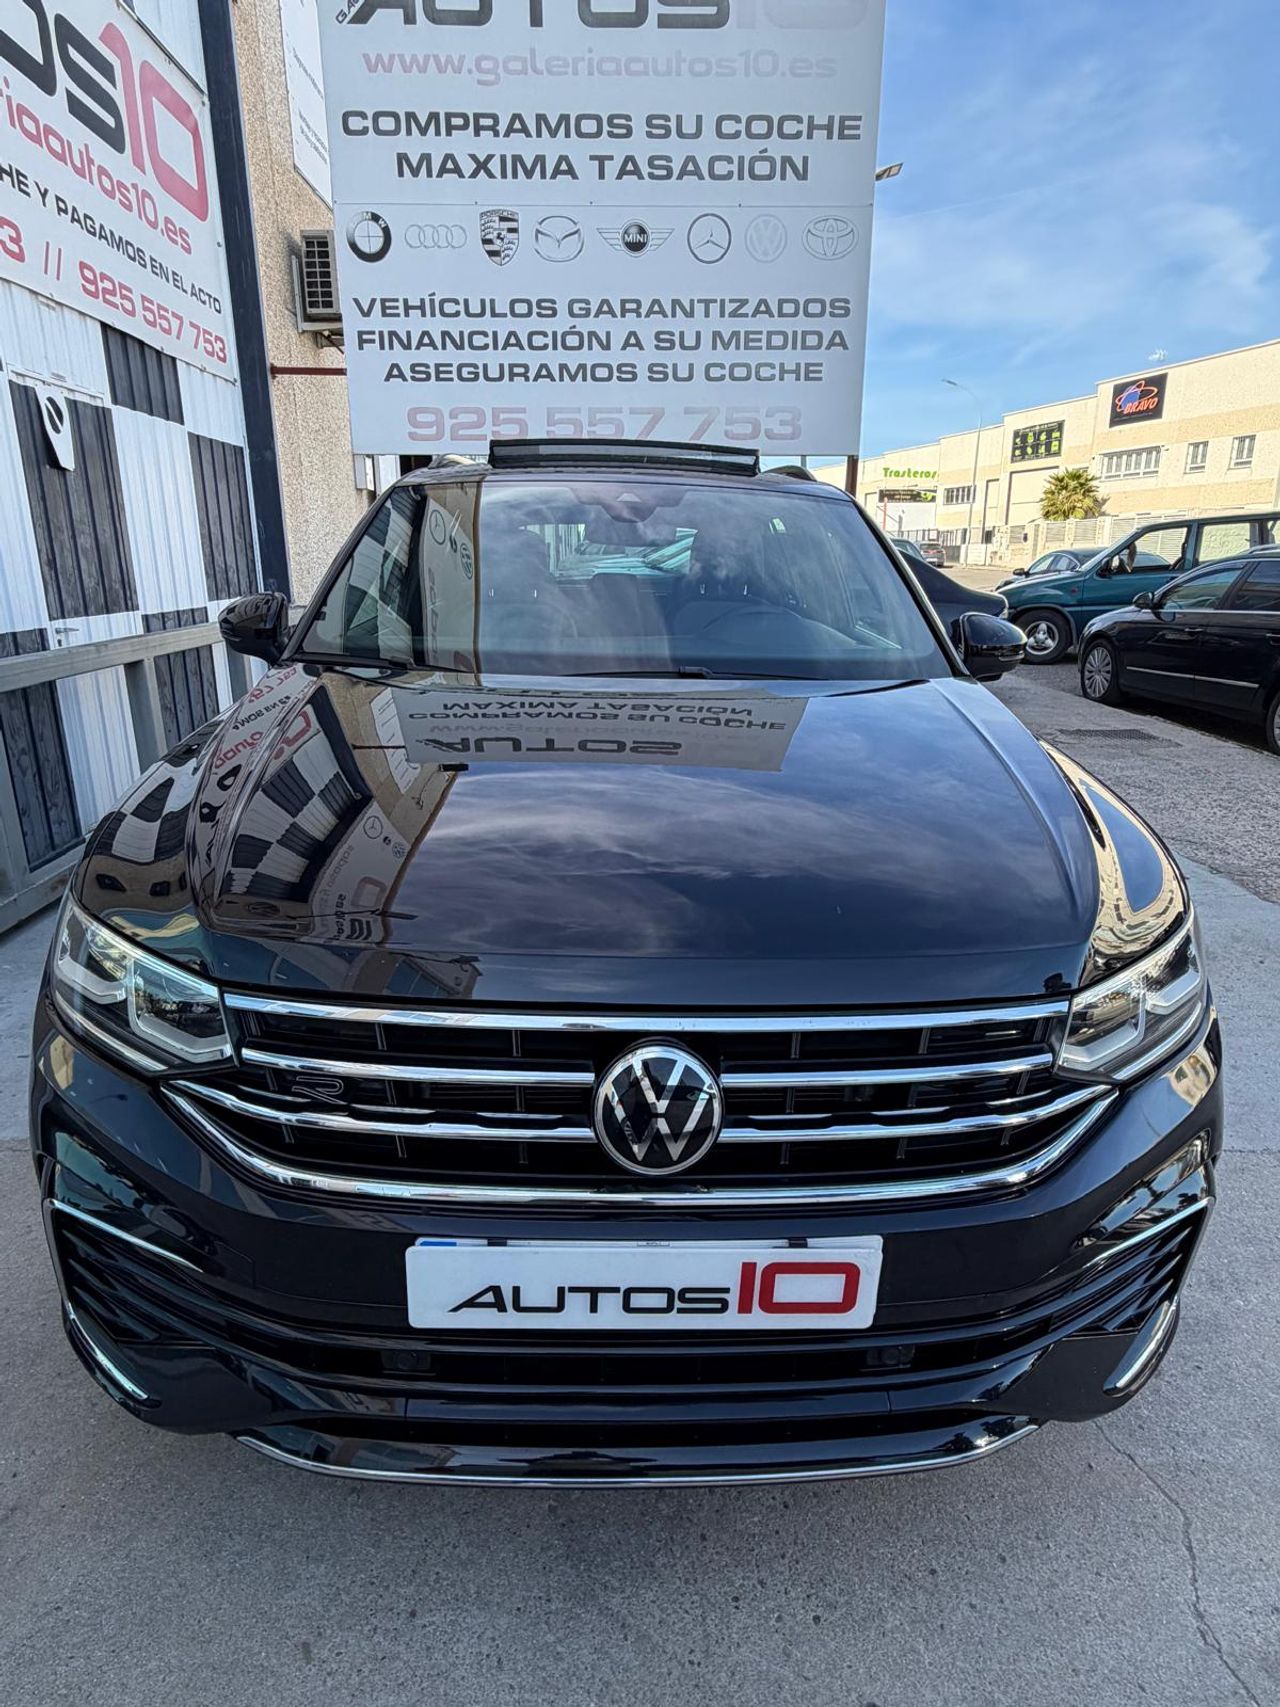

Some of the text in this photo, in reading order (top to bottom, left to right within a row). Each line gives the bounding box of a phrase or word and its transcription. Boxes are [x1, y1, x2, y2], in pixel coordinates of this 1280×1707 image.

[362, 47, 838, 86] www.galeriaautos10.es
[341, 110, 633, 139] COMPRAMOS
[645, 113, 703, 140] SU
[715, 114, 862, 140] COCHE
[0, 75, 192, 255] iaautos10.es
[396, 147, 809, 181] MAXIMA TASACIÓN
[33, 180, 49, 207] Y
[54, 194, 147, 269] PAGAMOS
[149, 254, 170, 284] EN
[172, 270, 188, 294] EL
[190, 282, 222, 314] ACTO
[78, 260, 136, 318] 925
[140, 293, 184, 341] 557
[188, 320, 227, 364] 753
[352, 291, 851, 318] VEHÍCULOS GARANTIZADOS
[357, 324, 849, 351] FINANCIACIÓN A SU MEDIDA
[384, 362, 824, 383] ASEGURAMOS SU COCHE
[1123, 397, 1159, 414] BRAVO
[407, 406, 801, 441] 925 557 753
[883, 467, 938, 479] Trasteros
